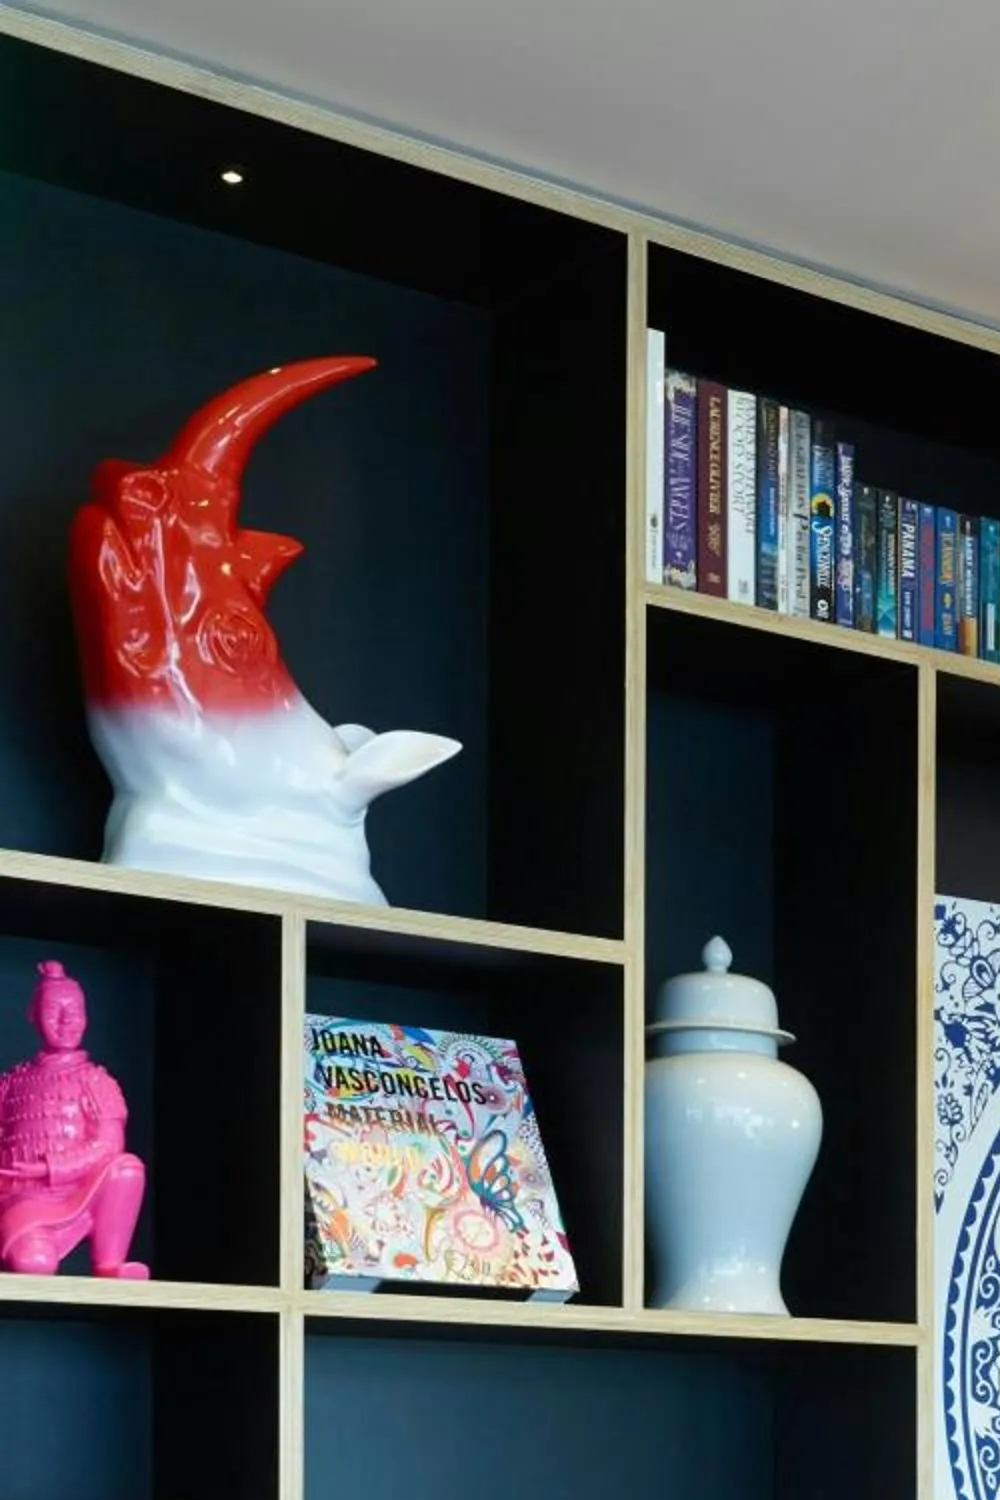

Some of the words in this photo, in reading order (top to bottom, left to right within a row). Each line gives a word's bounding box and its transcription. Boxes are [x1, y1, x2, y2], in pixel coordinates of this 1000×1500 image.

[708, 395, 721, 461] LAURENCE
[708, 461, 721, 515] OLIVIER
[901, 522, 915, 578] PANAMA
[310, 1027, 384, 1058] JOANA
[319, 1066, 487, 1105] VASCONCELOS
[326, 1103, 438, 1135] MATERIAL
